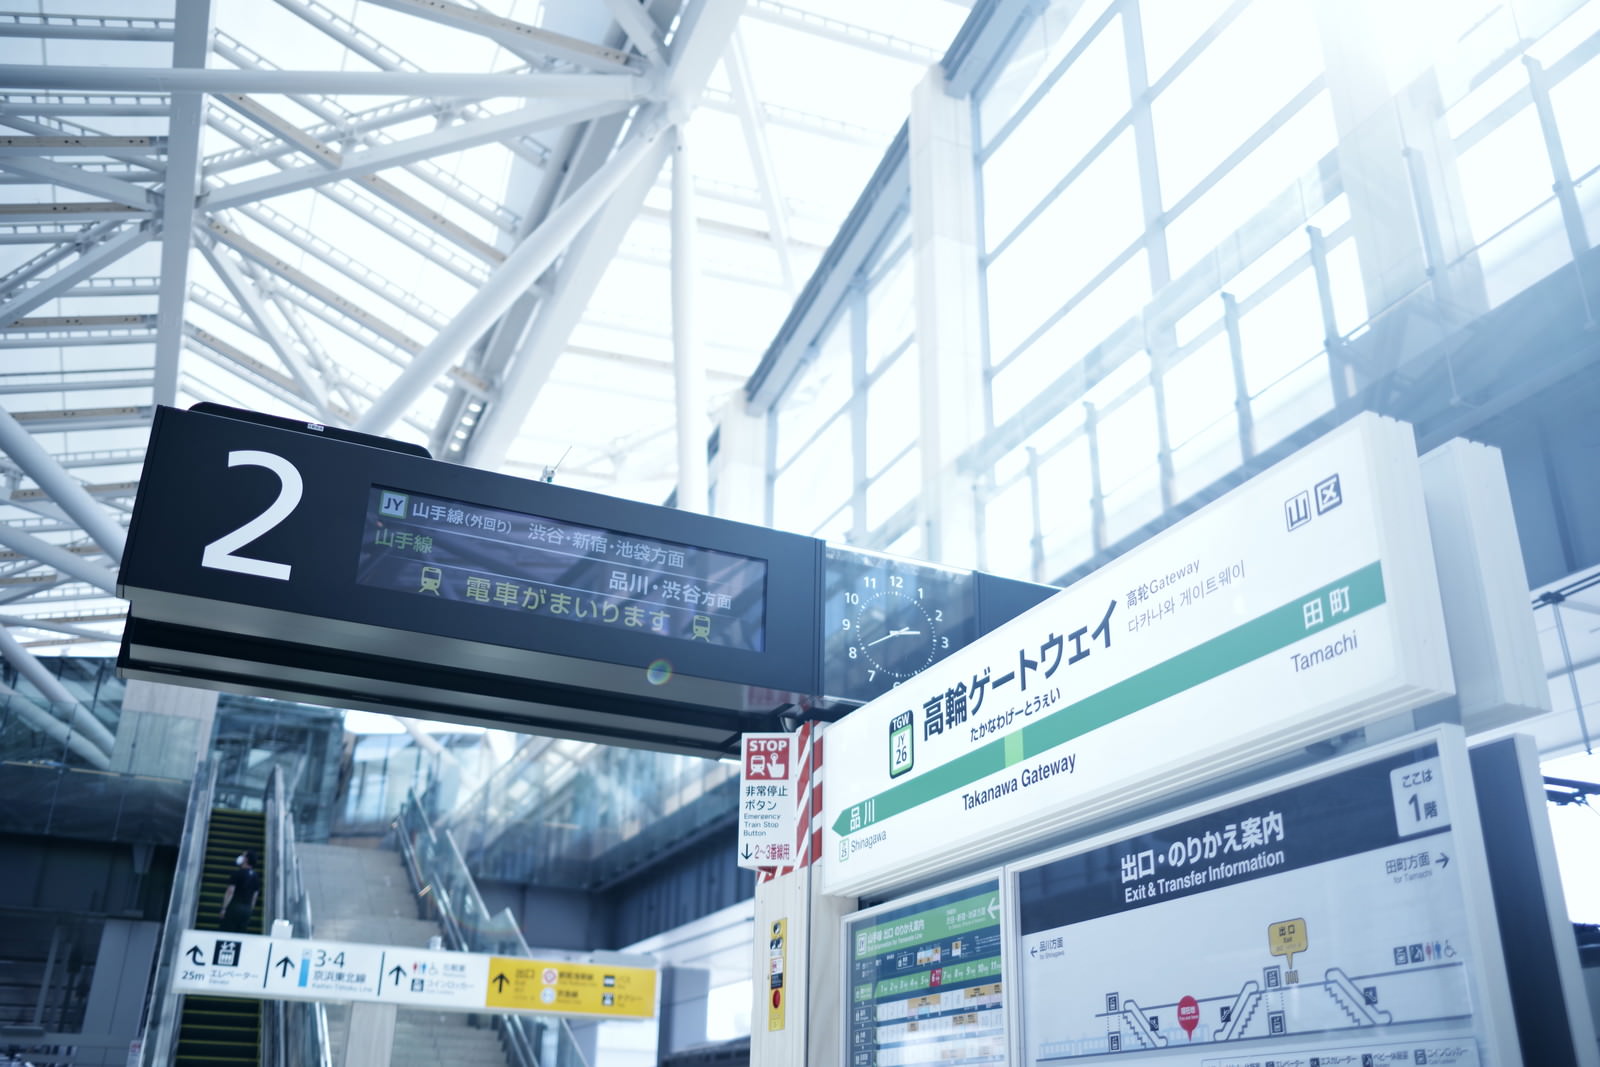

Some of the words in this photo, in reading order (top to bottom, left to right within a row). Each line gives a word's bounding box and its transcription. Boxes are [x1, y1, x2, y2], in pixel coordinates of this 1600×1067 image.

[202, 450, 304, 581] 2
[375, 529, 433, 554] 山手線
[384, 494, 403, 513] JY
[528, 523, 686, 569] 渋谷・新宿・池袋方面
[863, 576, 876, 589] 11
[889, 575, 904, 588] 12
[466, 575, 671, 632] 電車がまいります
[844, 592, 859, 605] 10
[917, 588, 924, 600] 1
[1127, 596, 1175, 632] 다카나와
[1180, 559, 1246, 607] 게이트웨이
[935, 609, 943, 622] 2
[1302, 586, 1350, 630] 田町
[842, 618, 851, 631] 9
[941, 636, 949, 649] 3
[1290, 630, 1359, 673] Tamachi
[848, 647, 857, 659] 8
[867, 670, 876, 682] 7
[922, 599, 1118, 742] 高輪ゲートウェイ
[892, 711, 910, 731] TGW
[970, 687, 1061, 743] たかなわげーとうえい
[749, 740, 787, 752] STOP
[897, 735, 905, 747] JY
[896, 745, 907, 765] 26
[962, 776, 1018, 811] Takanawa
[1020, 753, 1076, 793] Gateway
[1402, 768, 1433, 788] ここは
[745, 785, 789, 797] 非常停止
[745, 799, 777, 811] ボタン
[850, 798, 875, 832] 品川
[1408, 793, 1438, 822] 1階
[744, 812, 781, 821] Emergency
[763, 821, 779, 829] Stop
[743, 829, 767, 837] Button
[850, 830, 887, 853] Shinagawa
[1120, 810, 1285, 884] 出口・のりかえ案内
[1385, 851, 1430, 874] 田町方面
[1124, 884, 1147, 903] Exit
[1147, 881, 1156, 897] &
[1157, 870, 1207, 895] Transfer
[1208, 850, 1285, 882] Information
[181, 970, 205, 981] 25m
